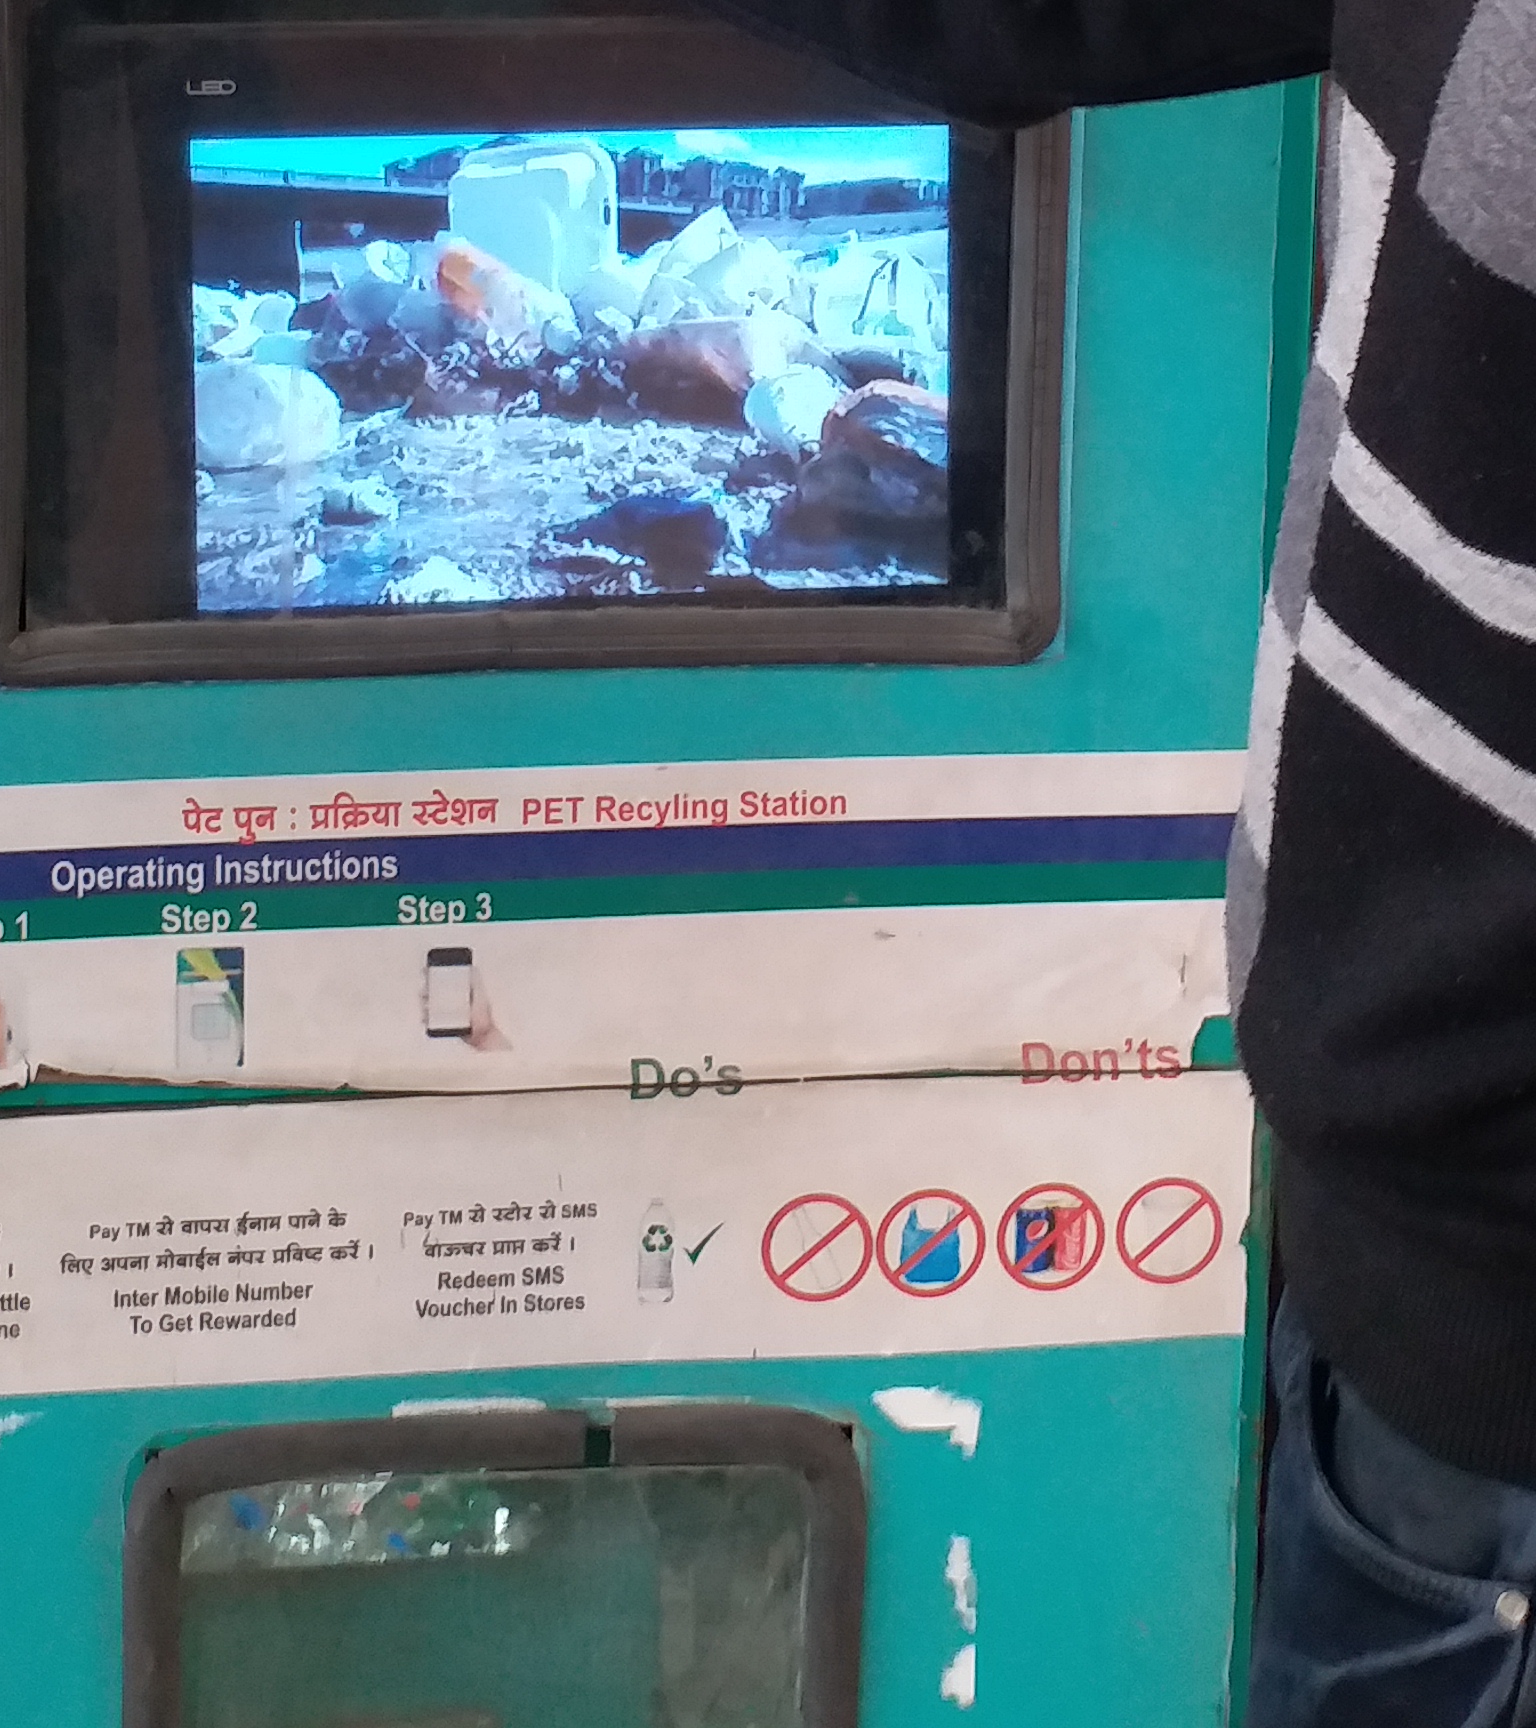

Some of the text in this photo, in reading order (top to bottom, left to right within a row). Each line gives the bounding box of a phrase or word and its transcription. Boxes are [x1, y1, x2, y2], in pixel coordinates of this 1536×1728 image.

[186, 78, 237, 96] LED
[182, 798, 224, 836] पेट
[310, 791, 401, 832] प्रक्रिया
[411, 789, 499, 829] स्टेशन
[521, 796, 584, 826] PET
[595, 793, 729, 828] Recyling
[739, 788, 848, 819] Station
[51, 852, 398, 897] Operating Instructions
[160, 901, 258, 937] Step 2
[397, 893, 493, 927] Step 3
[16, 912, 30, 940] 1
[1020, 1038, 1183, 1085] Don'ts
[89, 1224, 121, 1243] Pay
[126, 1222, 151, 1237] TM
[156, 1215, 175, 1236] से
[181, 1218, 230, 1234] वापस
[287, 1207, 322, 1229] पाने
[327, 1206, 348, 1228] के
[403, 1211, 434, 1230] Pay
[438, 1210, 463, 1226] TM
[468, 1202, 487, 1224] से
[491, 1200, 534, 1222] स्टोर
[561, 1202, 598, 1219] SMS
[531, 1230, 563, 1253] करें
[60, 1252, 95, 1276] लिए
[100, 1254, 150, 1272] अपना
[329, 1238, 362, 1260] करें
[437, 1264, 565, 1291] Redeem SMS
[113, 1280, 314, 1308] Inter Mobile Number
[415, 1292, 586, 1319] Voucher In Stores
[129, 1307, 297, 1335] To Get Rewarded
